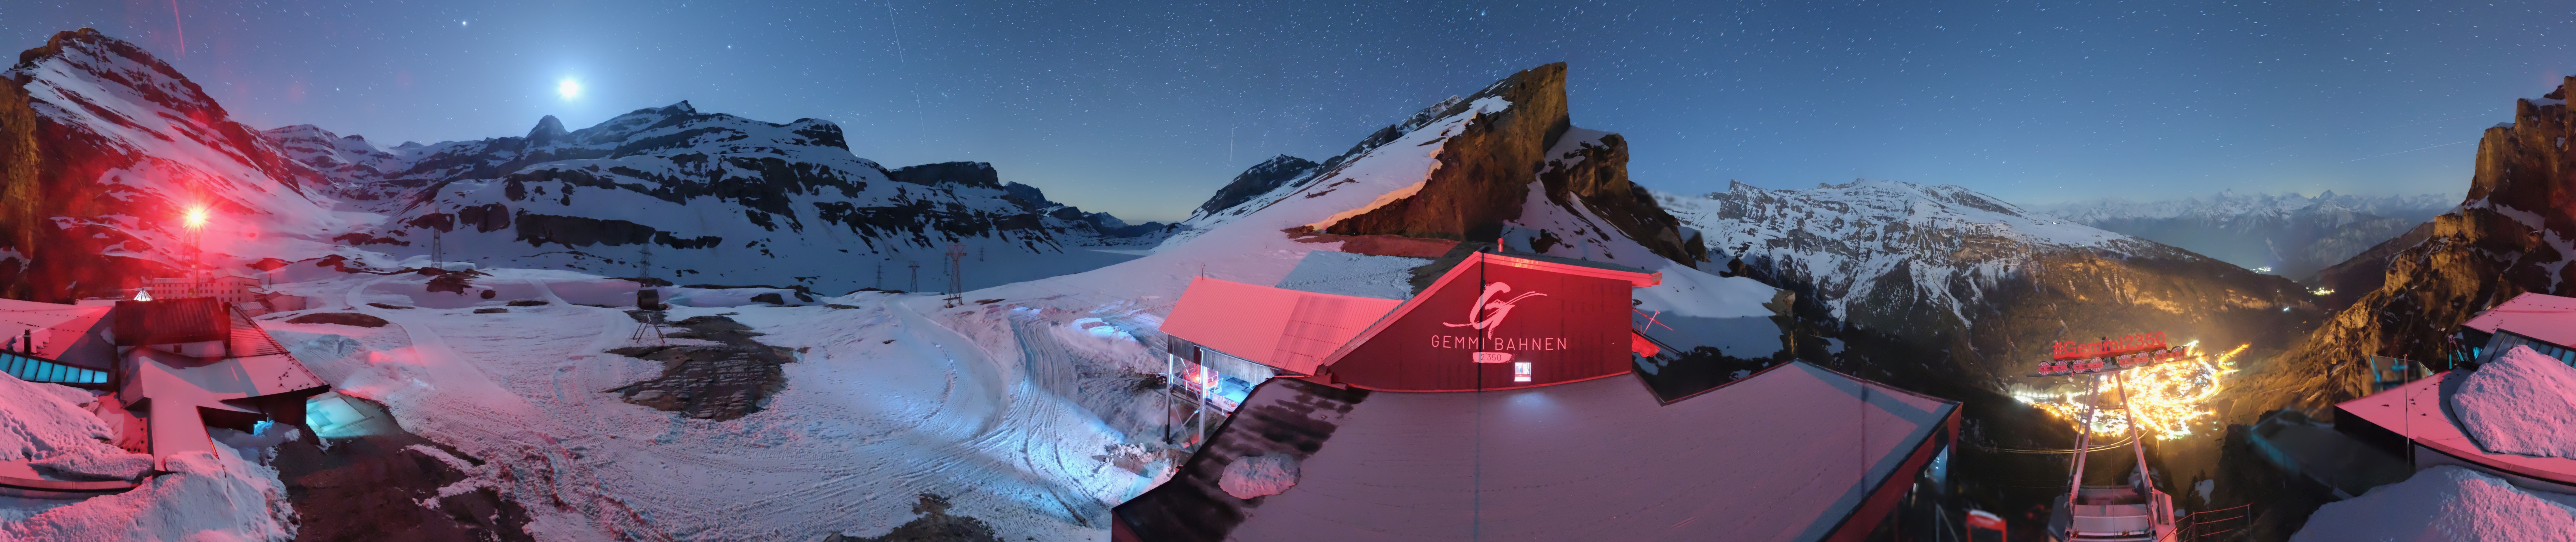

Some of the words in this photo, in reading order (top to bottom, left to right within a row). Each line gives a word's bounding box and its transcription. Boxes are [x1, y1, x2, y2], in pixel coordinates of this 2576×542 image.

[1432, 335, 1484, 350] GEMMI
[1495, 338, 1566, 350] BAHNEN
[2053, 331, 2165, 355] #Gemmi2350
